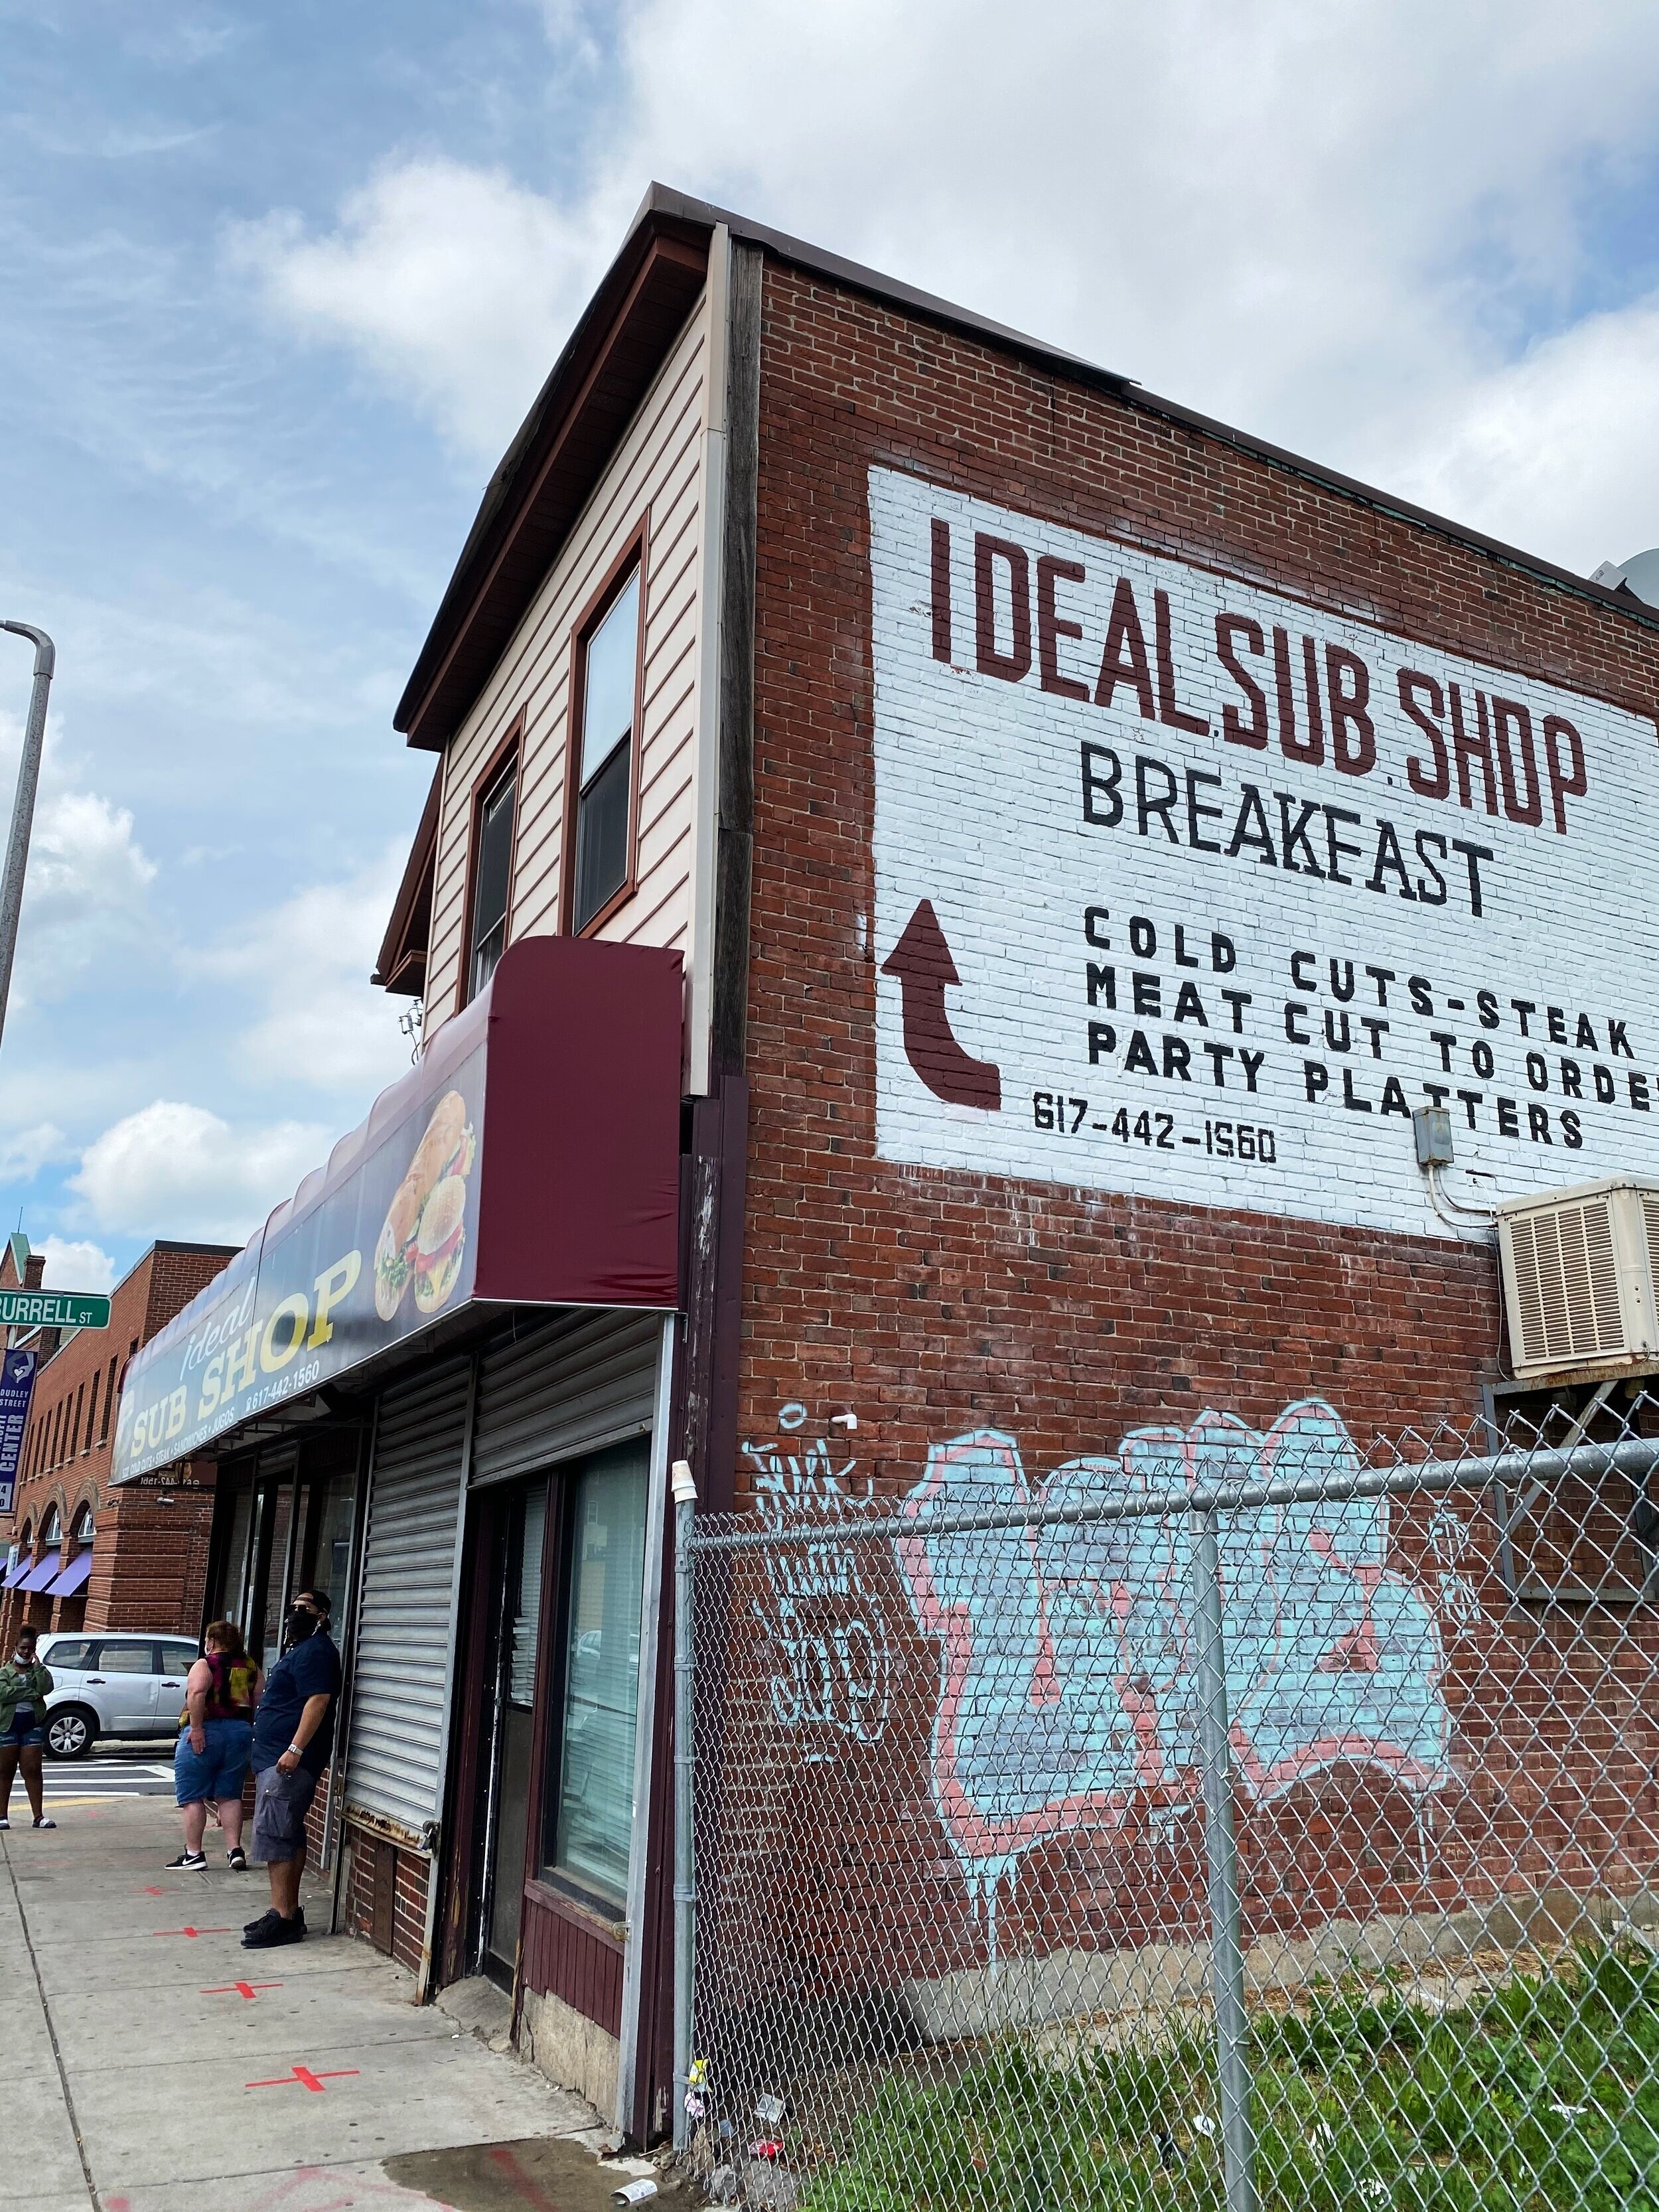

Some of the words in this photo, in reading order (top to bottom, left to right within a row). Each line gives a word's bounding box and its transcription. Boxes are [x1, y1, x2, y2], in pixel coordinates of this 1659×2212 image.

[1396, 667, 1587, 835] SHOP
[1080, 740, 1494, 918] BREAKFAST
[1084, 906, 1236, 974] COLD
[1086, 962, 1252, 1034] MEAT
[1284, 1002, 1390, 1060] CUT
[1429, 1031, 1494, 1079] TO
[1526, 1051, 1659, 1112] ORDE
[1033, 1091, 1277, 1164] 617-442-1560
[1088, 1021, 1265, 1093] PARTY
[1303, 1060, 1583, 1149] PLATTERS
[78, 1311, 93, 1324] ST
[130, 1384, 188, 1458] SUB
[198, 1249, 362, 1422] SHOP
[179, 1276, 256, 1381] ideal
[252, 1359, 320, 1410] 617-442-1560
[0, 1415, 24, 1472] CENTER
[155, 1446, 171, 1465] STEAK
[173, 1424, 208, 1456] SANDWICHES
[211, 1407, 235, 1434] JUGOS
